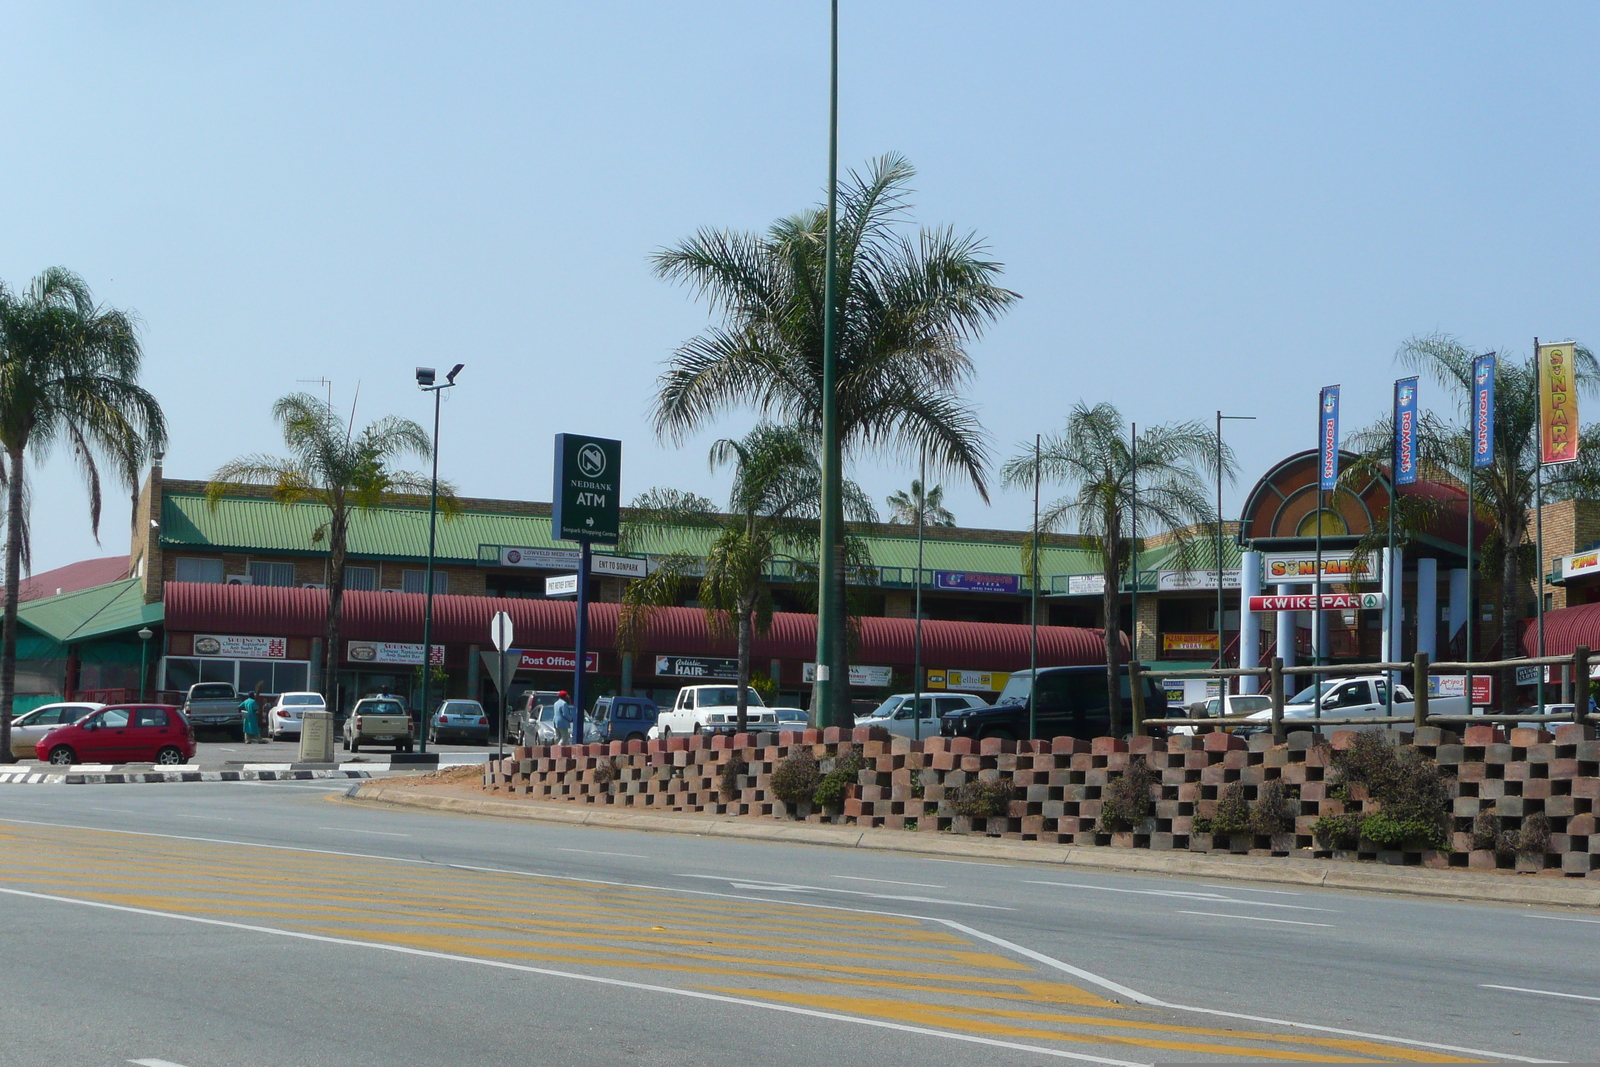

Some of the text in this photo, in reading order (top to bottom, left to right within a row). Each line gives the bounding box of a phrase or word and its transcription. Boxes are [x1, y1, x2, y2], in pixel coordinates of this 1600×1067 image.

[1477, 389, 1488, 455] ROMAN'S
[1401, 410, 1412, 473] ROMAN'S
[1324, 418, 1335, 479] ROMAN'S
[571, 479, 612, 491] NEDBANK
[576, 491, 606, 508] ATM
[562, 526, 580, 534] Sonpark
[582, 528, 602, 537] Shopping
[598, 560, 639, 572] ENT TO SONPARK
[965, 573, 1013, 584] ROMAN'S
[1262, 596, 1360, 609] KWIKSPAR
[522, 655, 576, 667] Post Office
[675, 658, 701, 666] Artistic
[675, 663, 703, 676] HAIR
[956, 675, 981, 684] Celltel
